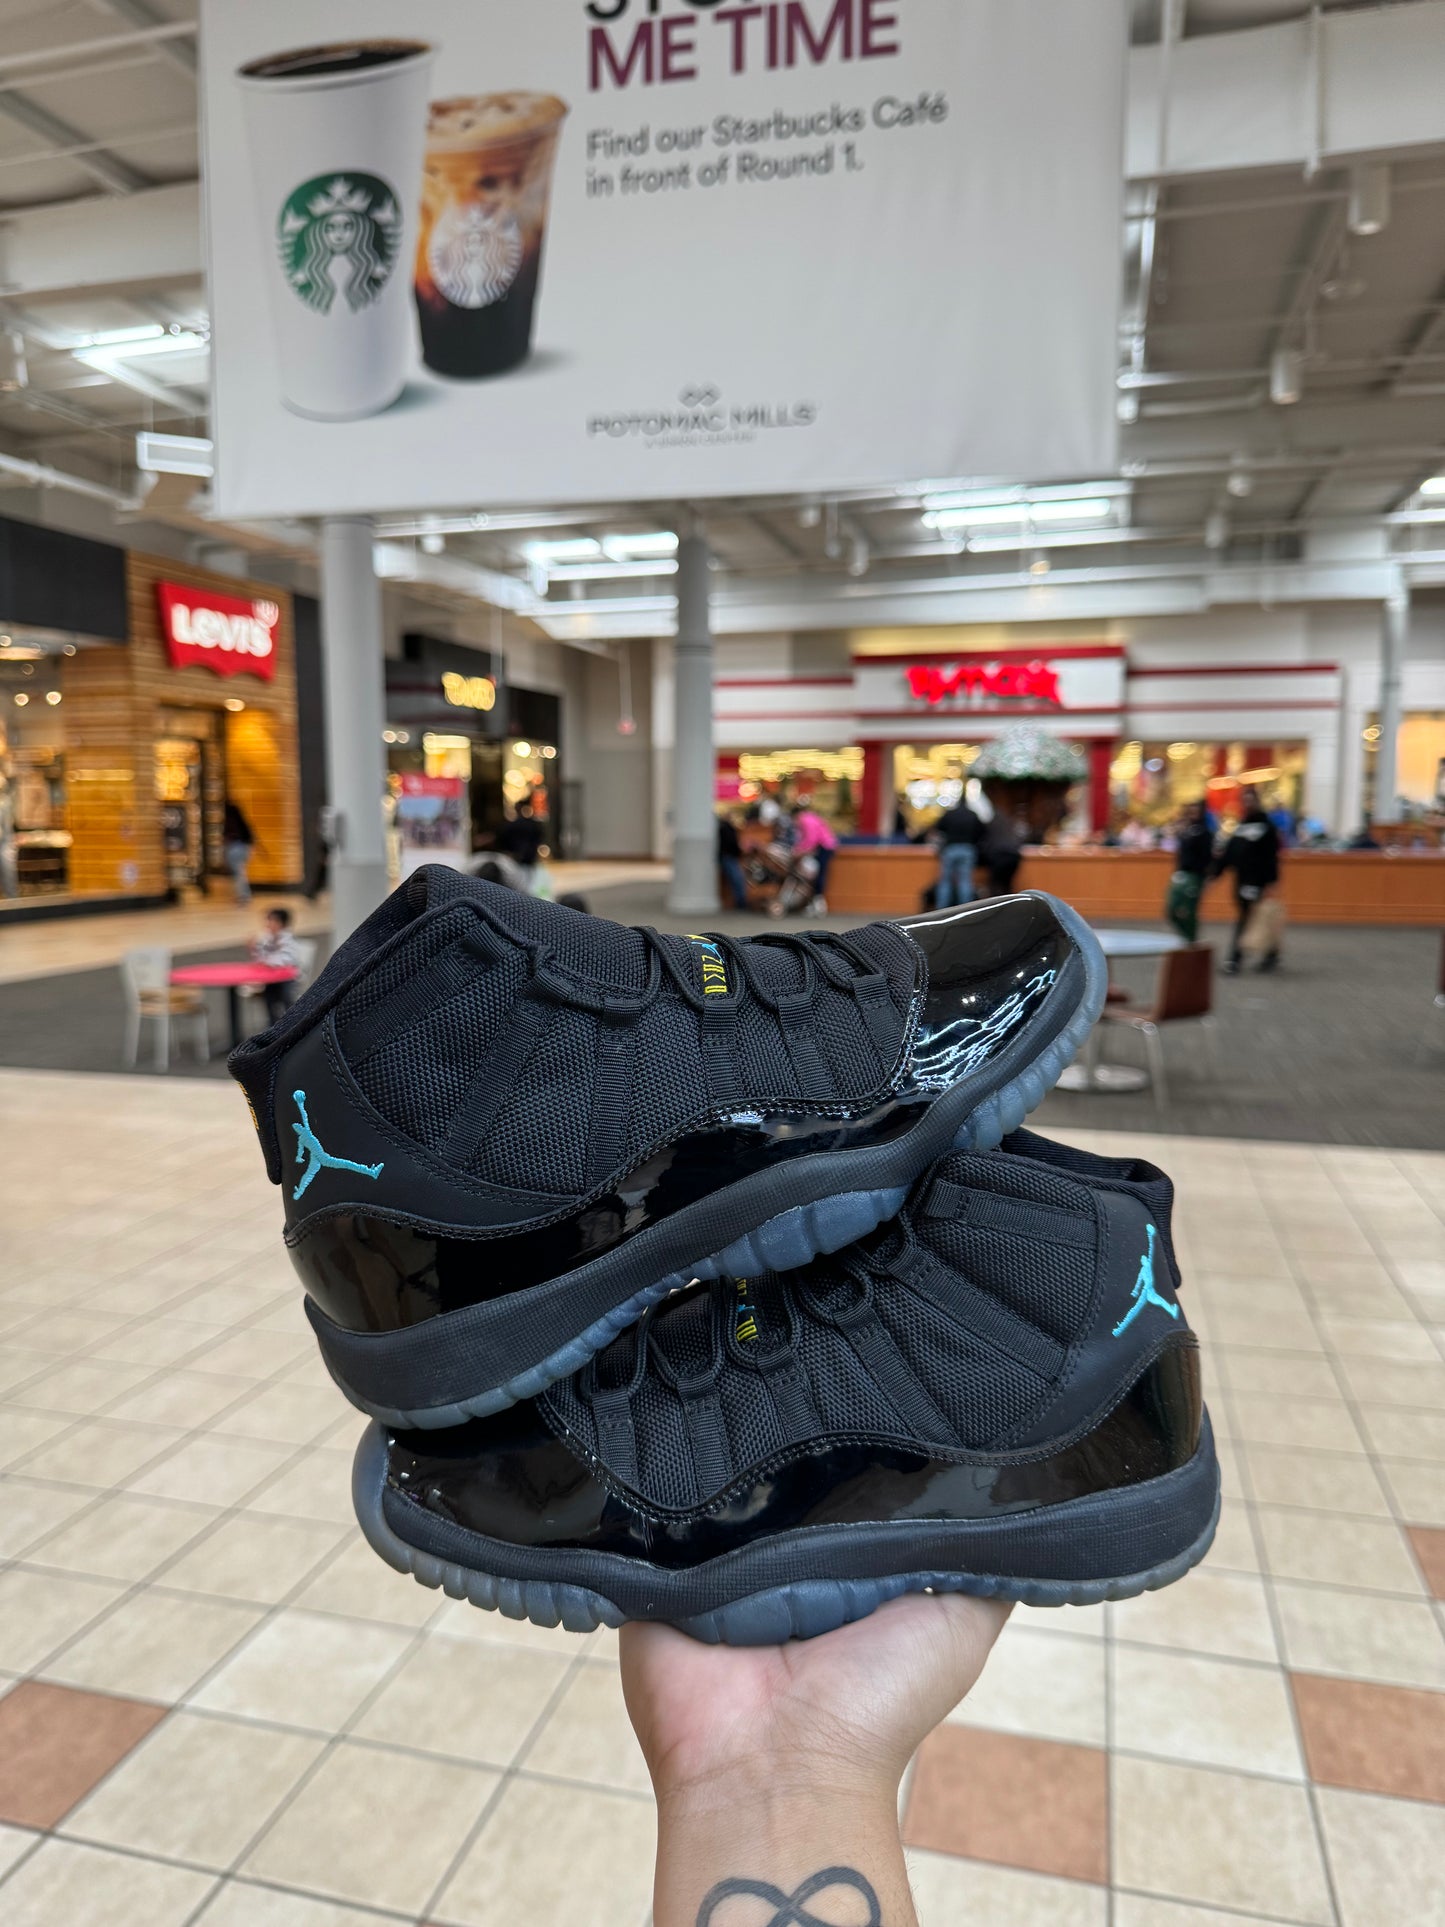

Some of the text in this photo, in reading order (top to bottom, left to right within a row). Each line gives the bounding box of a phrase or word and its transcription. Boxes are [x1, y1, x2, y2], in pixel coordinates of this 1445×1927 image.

[588, 0, 900, 92] ME TIME
[586, 93, 949, 161] Find our Starbucks Café
[586, 143, 864, 198] in front of Round 1.
[586, 403, 816, 437] POTOMAC MILLS
